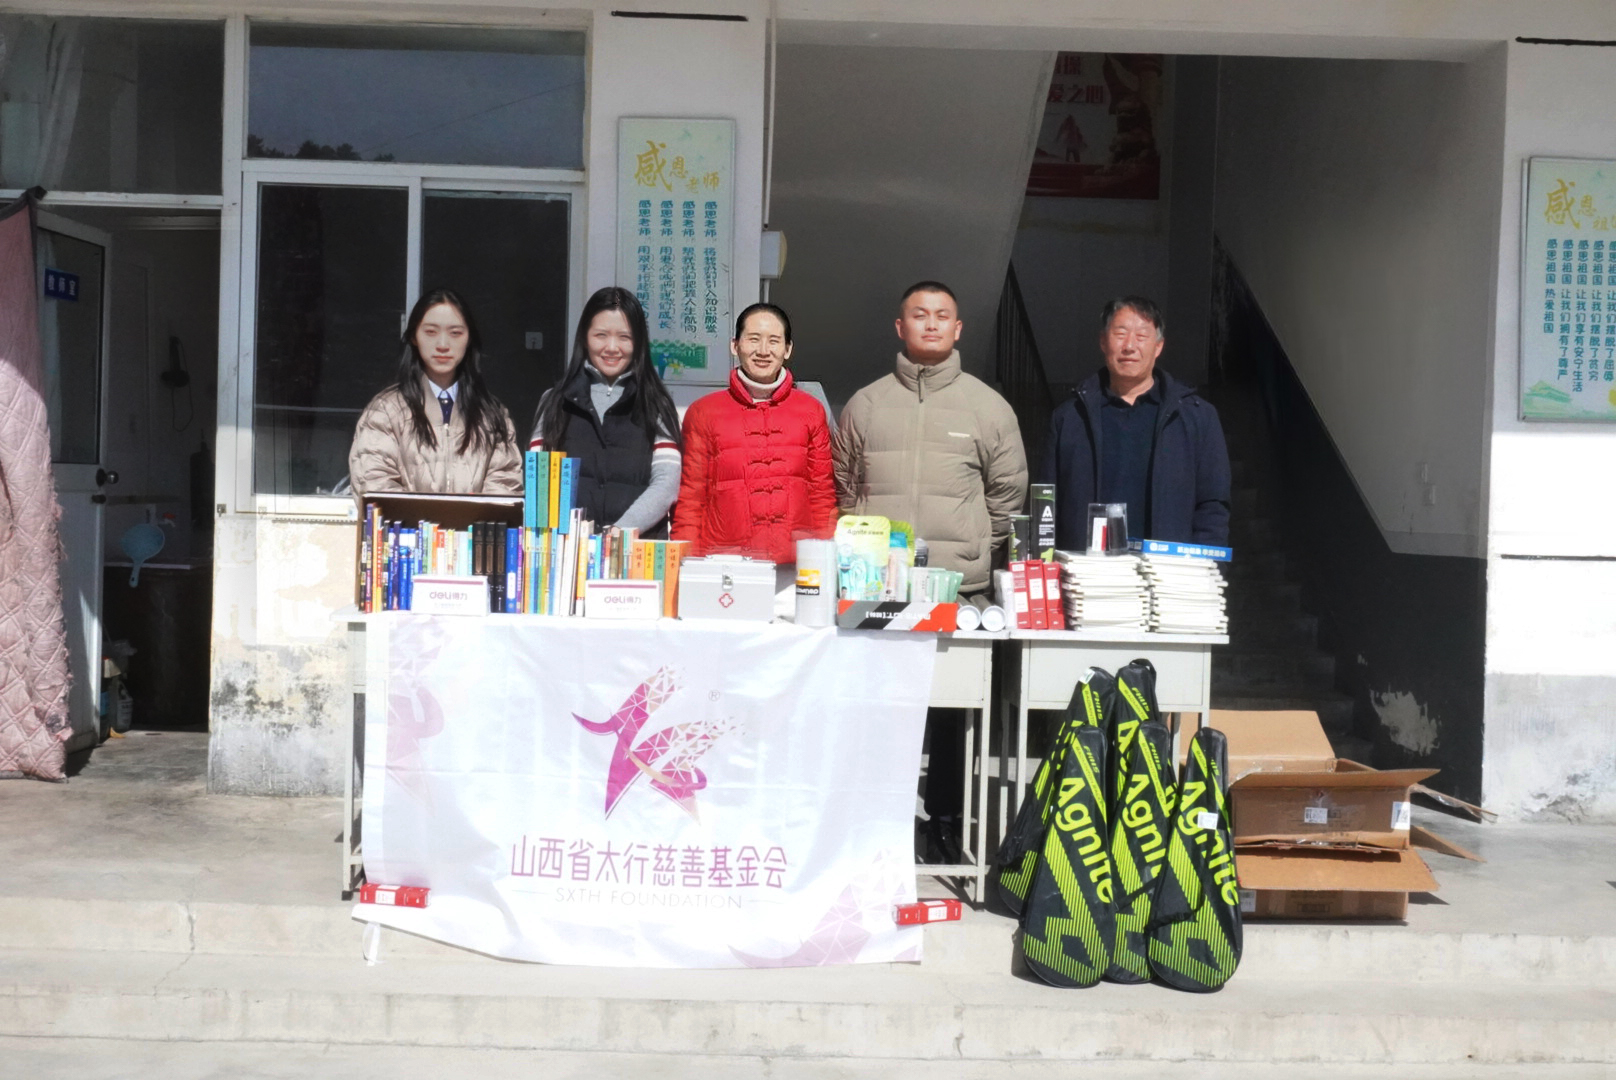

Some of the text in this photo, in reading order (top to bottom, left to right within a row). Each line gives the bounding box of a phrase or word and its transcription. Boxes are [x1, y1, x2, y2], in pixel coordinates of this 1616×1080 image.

[634, 140, 720, 194] 感恩老师
[638, 200, 652, 236] 感恩老师
[660, 200, 674, 237] 感恩老师
[682, 201, 696, 237] 感恩老师
[704, 201, 718, 238] 感恩老师
[1543, 239, 1558, 334] 感恩祖国 热爱祖国
[1561, 239, 1574, 285] 感恩祖国
[1572, 240, 1590, 393] 感恩祖国 让我们享有安宁生活
[1588, 240, 1605, 382] 感恩祖国 让我们摆脱了贫穷
[1055, 777, 1114, 904] Agnite
[1122, 774, 1167, 878] Agni
[510, 834, 788, 889] 山西省太行慈善基金会
[555, 887, 742, 910] SXTH FOUNDATION
